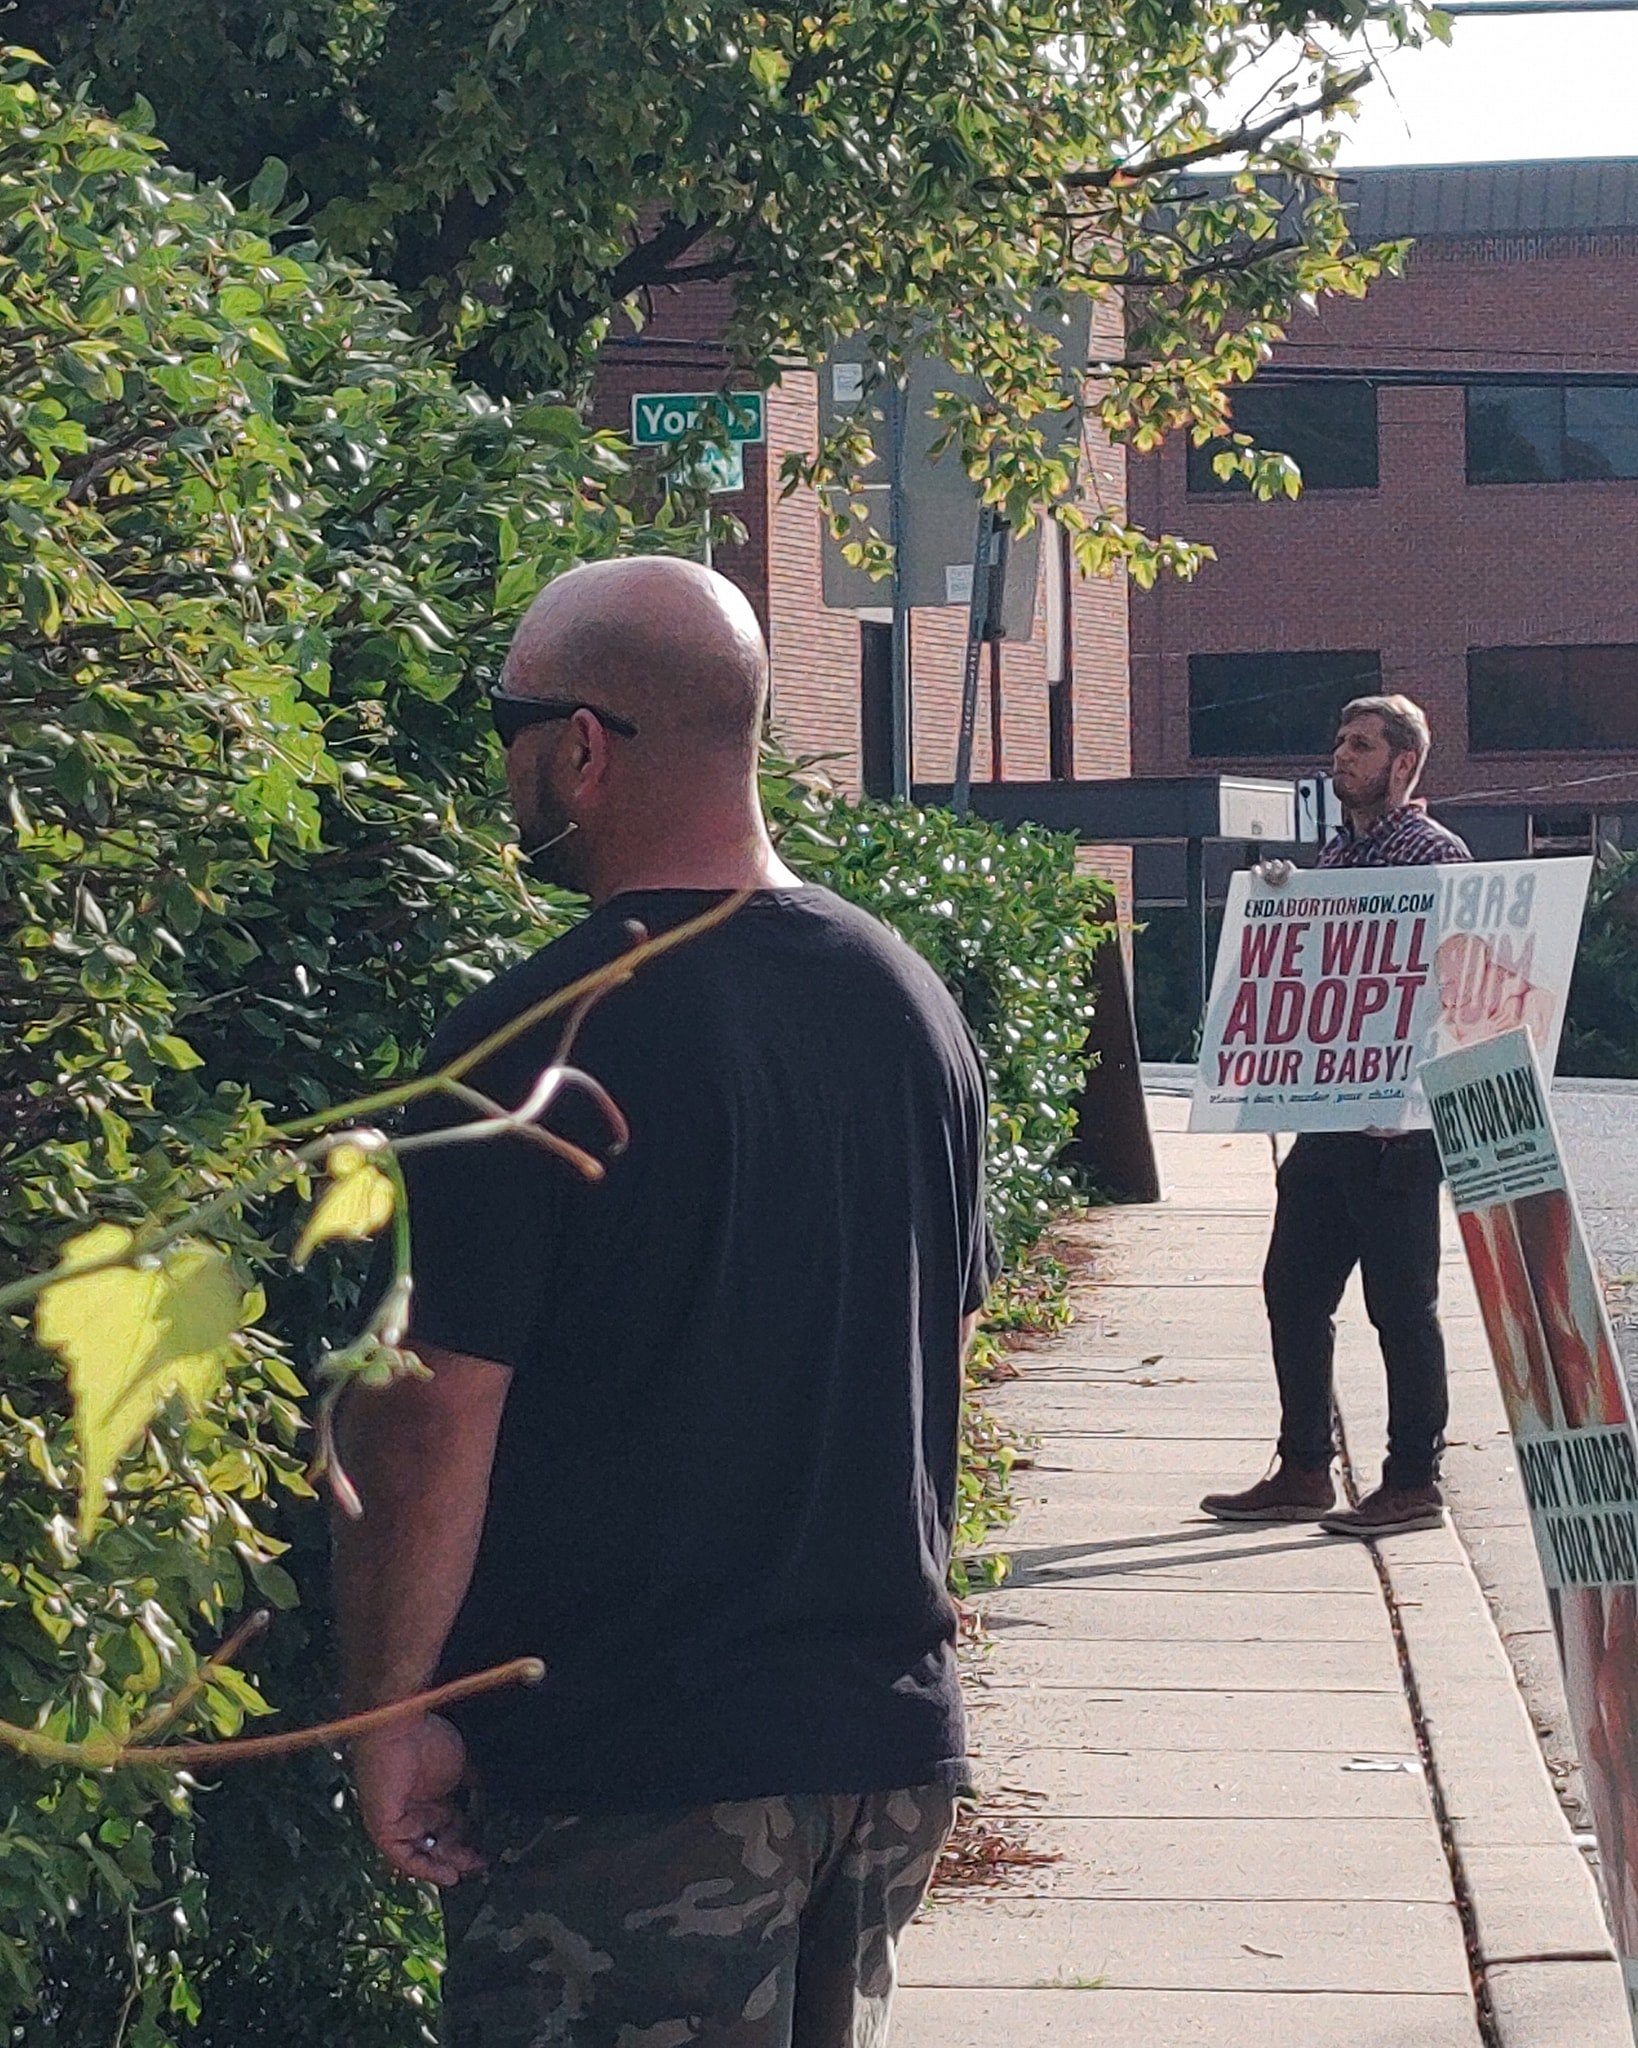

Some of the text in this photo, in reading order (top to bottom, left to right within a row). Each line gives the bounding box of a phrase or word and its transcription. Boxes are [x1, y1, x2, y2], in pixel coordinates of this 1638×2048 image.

[641, 400, 709, 434] Yor
[1245, 892, 1435, 919] ENDABORTIONNOW.COM
[1240, 918, 1430, 978] WE WILL
[1222, 974, 1427, 1045] ADOPT
[1217, 1045, 1414, 1086] YOUR BABY!
[1457, 1078, 1508, 1148] YOUR
[1496, 1066, 1545, 1135] BABY
[1546, 1515, 1603, 1584] YOUR
